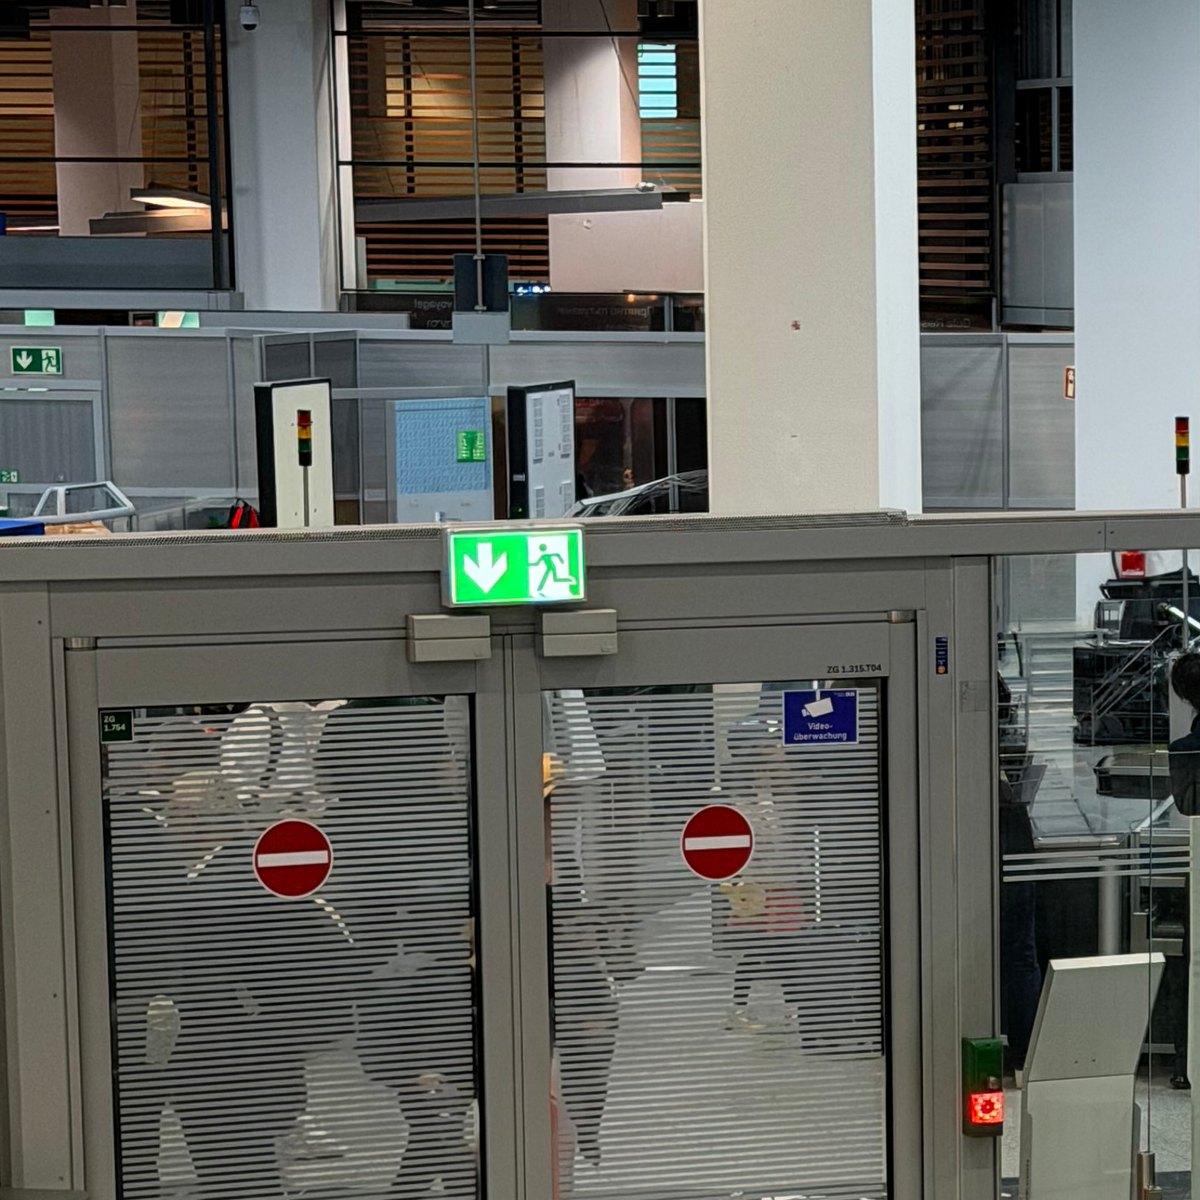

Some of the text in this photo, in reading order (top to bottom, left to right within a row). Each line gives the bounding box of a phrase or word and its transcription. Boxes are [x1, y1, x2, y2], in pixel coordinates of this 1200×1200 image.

[827, 665, 840, 674] ZG
[103, 715, 116, 724] ZG
[807, 722, 833, 730] Video-
[793, 732, 848, 741] überwachung
